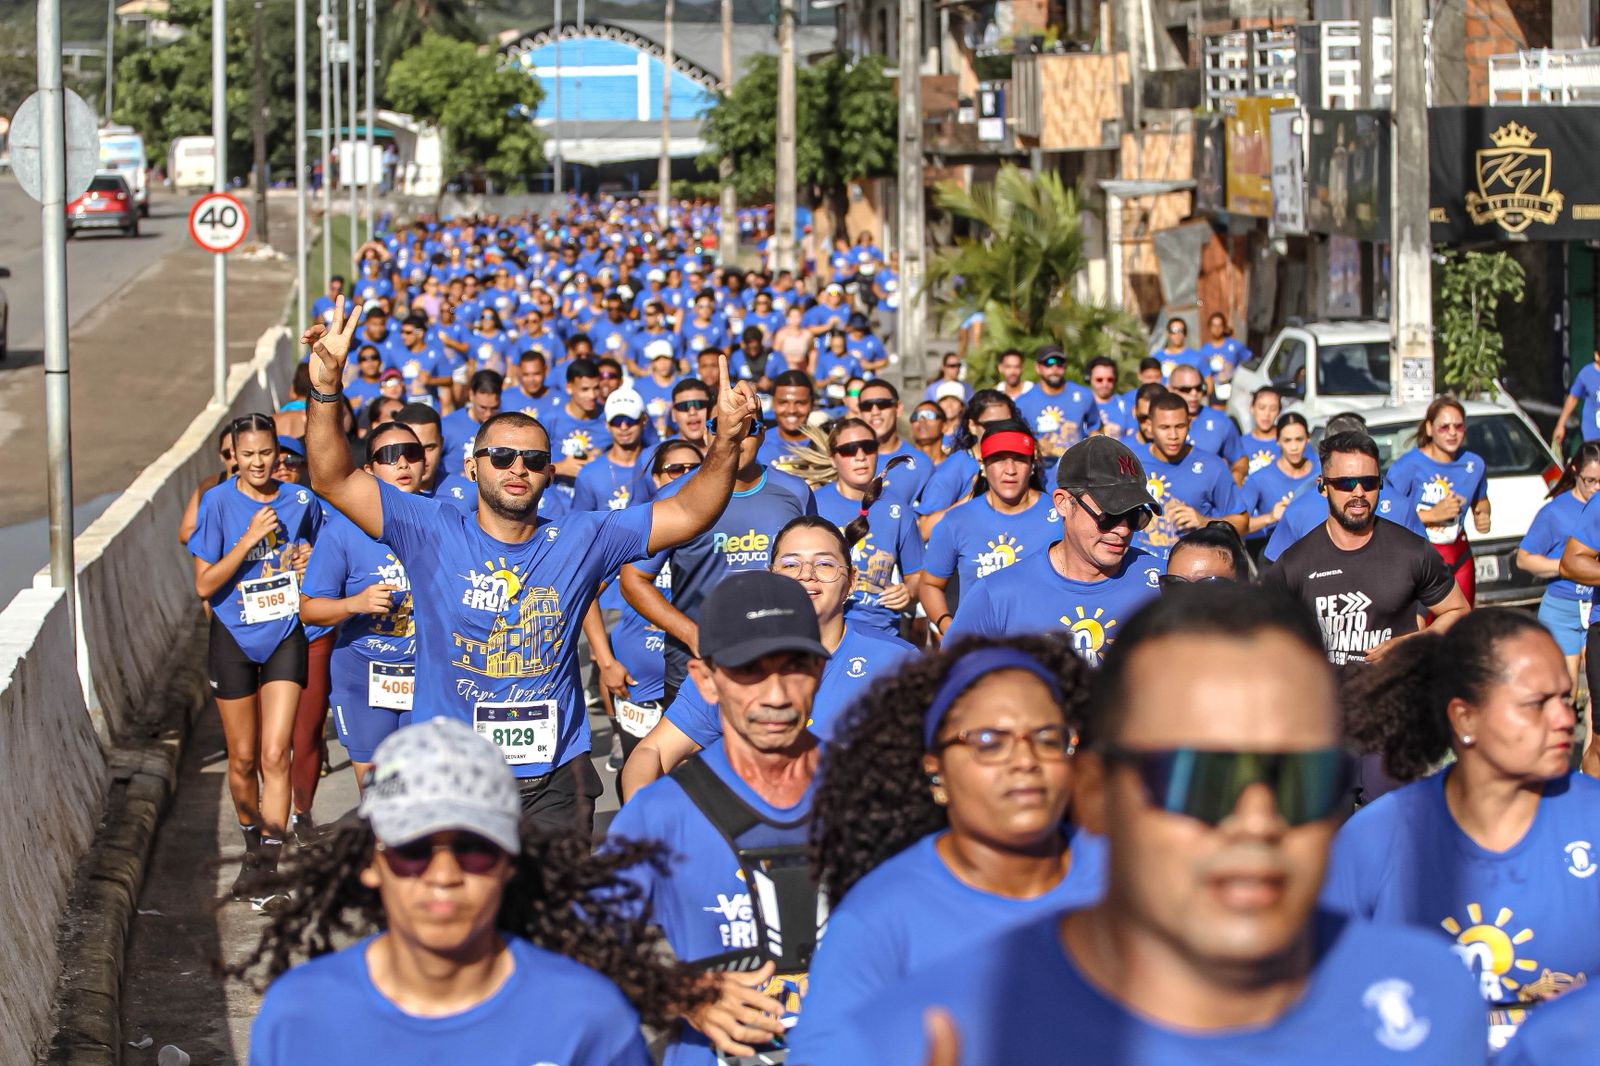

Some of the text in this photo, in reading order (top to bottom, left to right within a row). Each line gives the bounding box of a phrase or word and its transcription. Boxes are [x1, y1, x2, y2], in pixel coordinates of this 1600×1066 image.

[199, 206, 238, 229] 40
[713, 528, 769, 553] Rede
[1316, 569, 1343, 578] HONDA
[257, 592, 285, 609] 5169
[1315, 594, 1338, 617] PE
[621, 705, 645, 725] 5011
[492, 727, 535, 747] 8129
[537, 744, 548, 752] 8K
